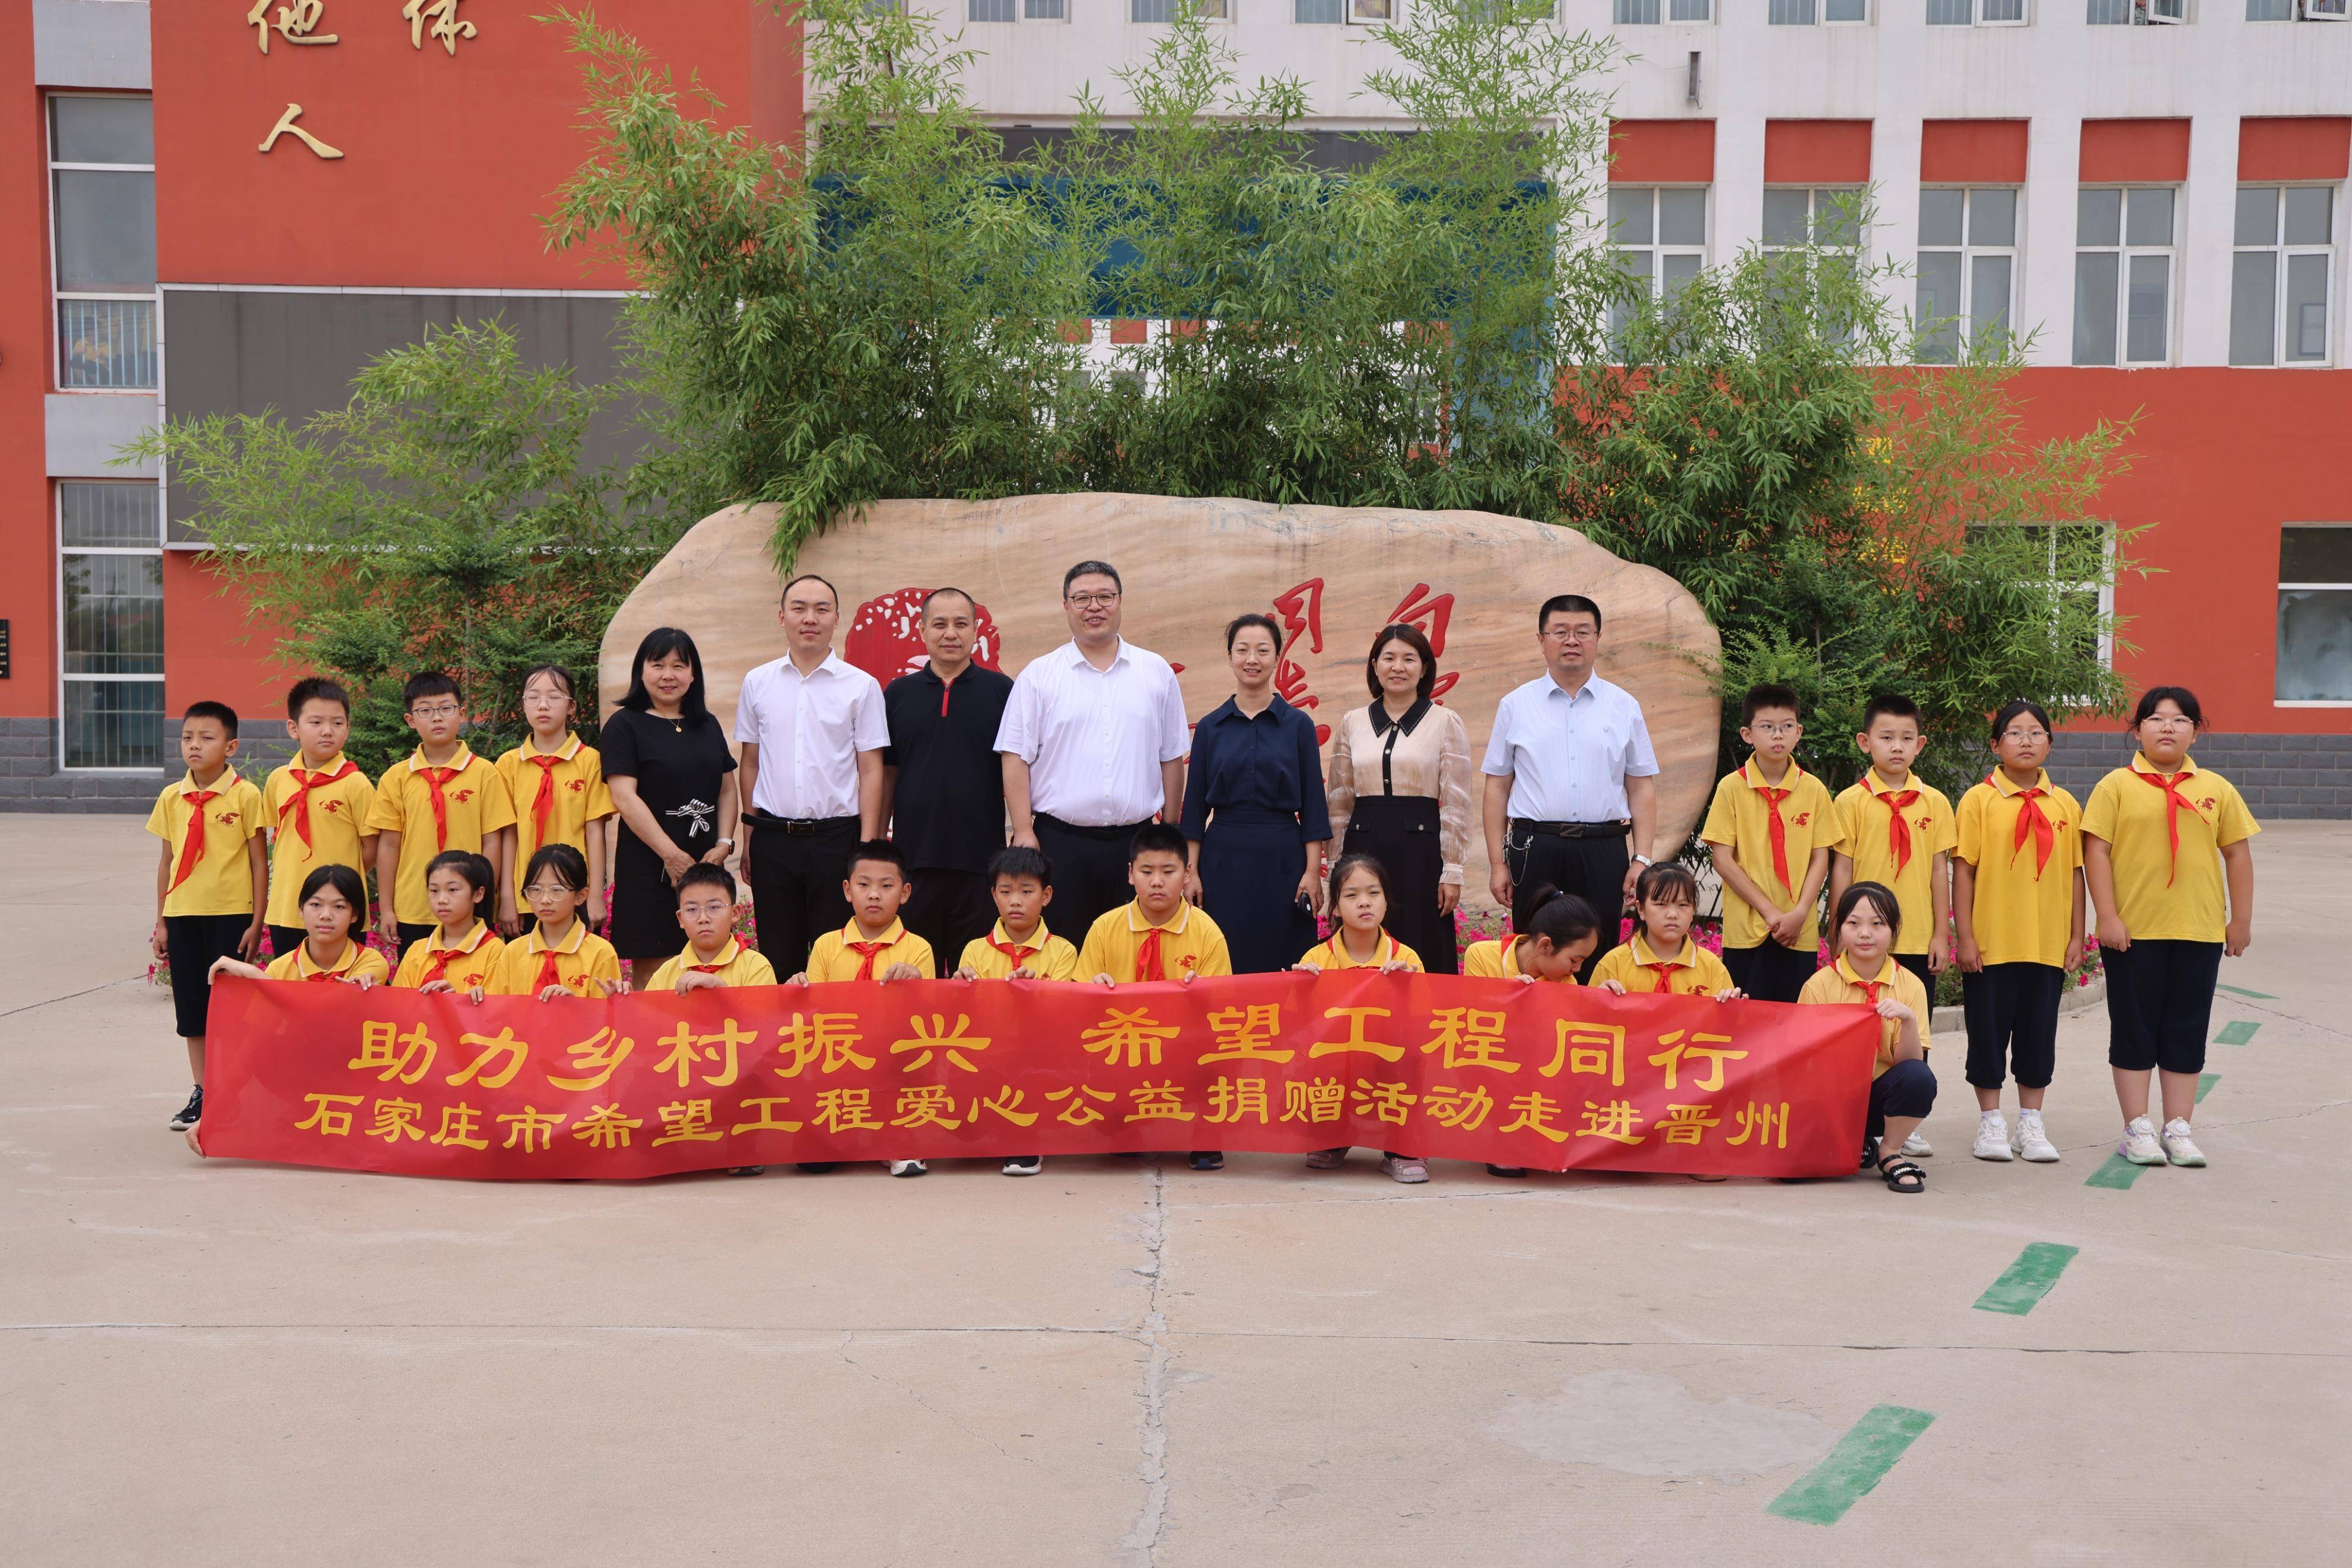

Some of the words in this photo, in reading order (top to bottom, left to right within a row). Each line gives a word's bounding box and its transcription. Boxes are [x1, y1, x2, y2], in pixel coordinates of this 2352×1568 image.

[348, 1012, 991, 1091] 助力乡村振兴
[1081, 1004, 1749, 1092] 希望工程同行
[294, 1076, 1790, 1153] 石家庄市希望工程爱心公益捐赠活动走进晋州
